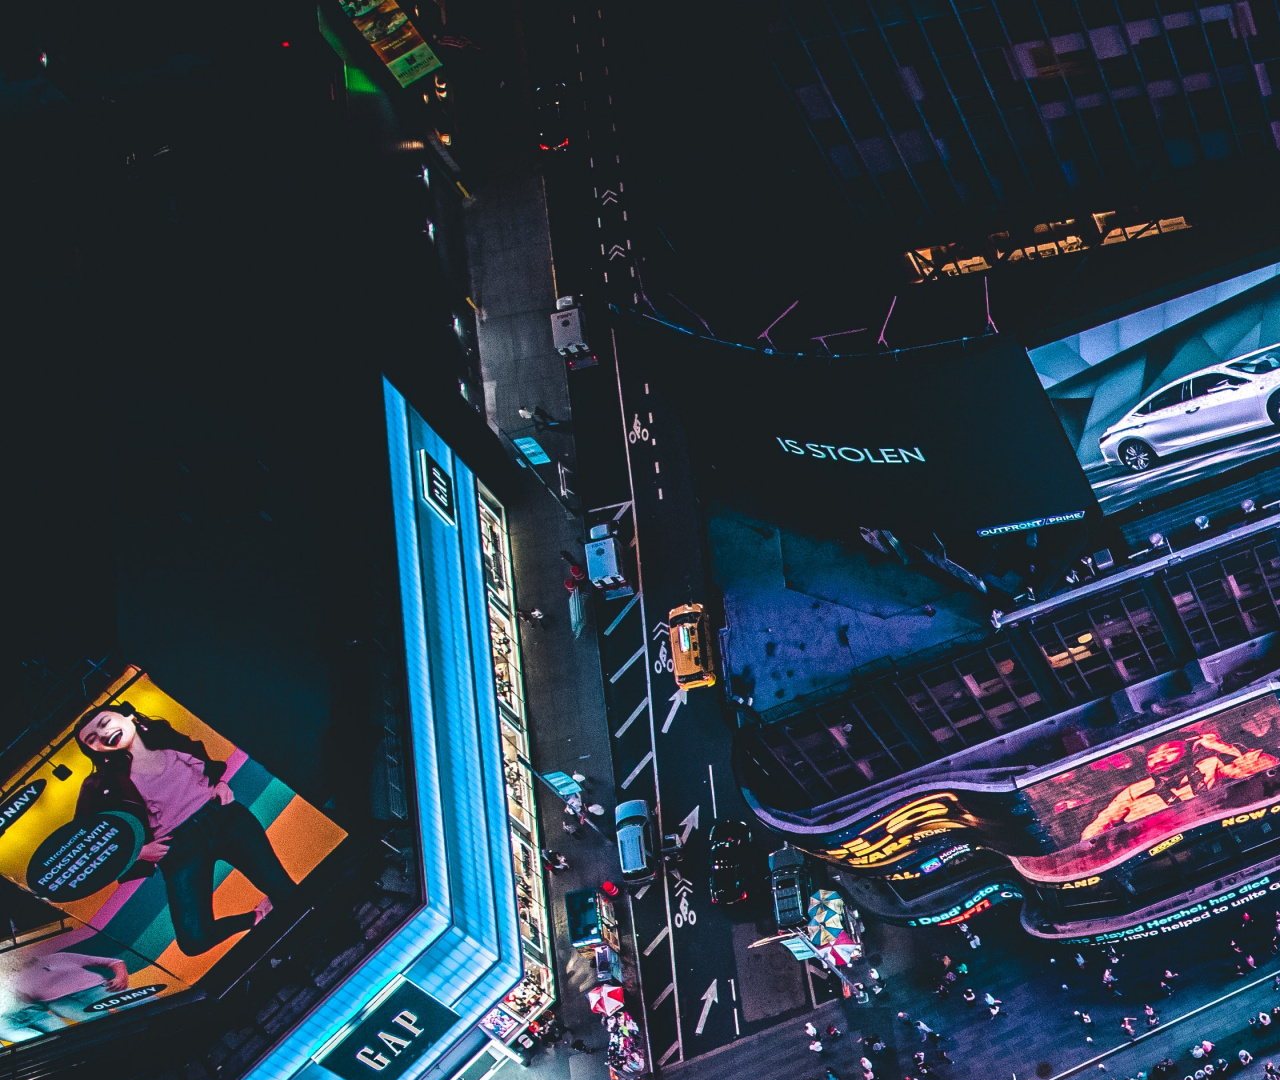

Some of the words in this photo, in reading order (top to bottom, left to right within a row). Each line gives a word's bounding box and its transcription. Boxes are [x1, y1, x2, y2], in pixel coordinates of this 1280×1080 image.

[776, 437, 804, 455] IS
[805, 442, 926, 463] STOLEN
[432, 467, 448, 506] GAP
[980, 520, 1042, 535] OUTFRONT
[1049, 512, 1082, 523] PRIME
[3, 786, 38, 818] NAVY
[1222, 808, 1267, 828] NOW
[38, 842, 86, 886] ROCKSTAR
[83, 820, 109, 843] WITH
[48, 827, 119, 892] SECRET-SLIM
[68, 843, 119, 888] POCKETS
[964, 884, 999, 909] actor
[1095, 924, 1145, 943] played
[1147, 903, 1208, 929] Hershel,
[1208, 892, 1237, 906] has
[1238, 876, 1271, 894] died
[1160, 911, 1211, 934] helped
[1212, 905, 1229, 915] to
[1230, 889, 1267, 908] unite
[93, 998, 121, 1010] OLD
[120, 986, 156, 1001] NAVY
[355, 1009, 424, 1071] GAP
